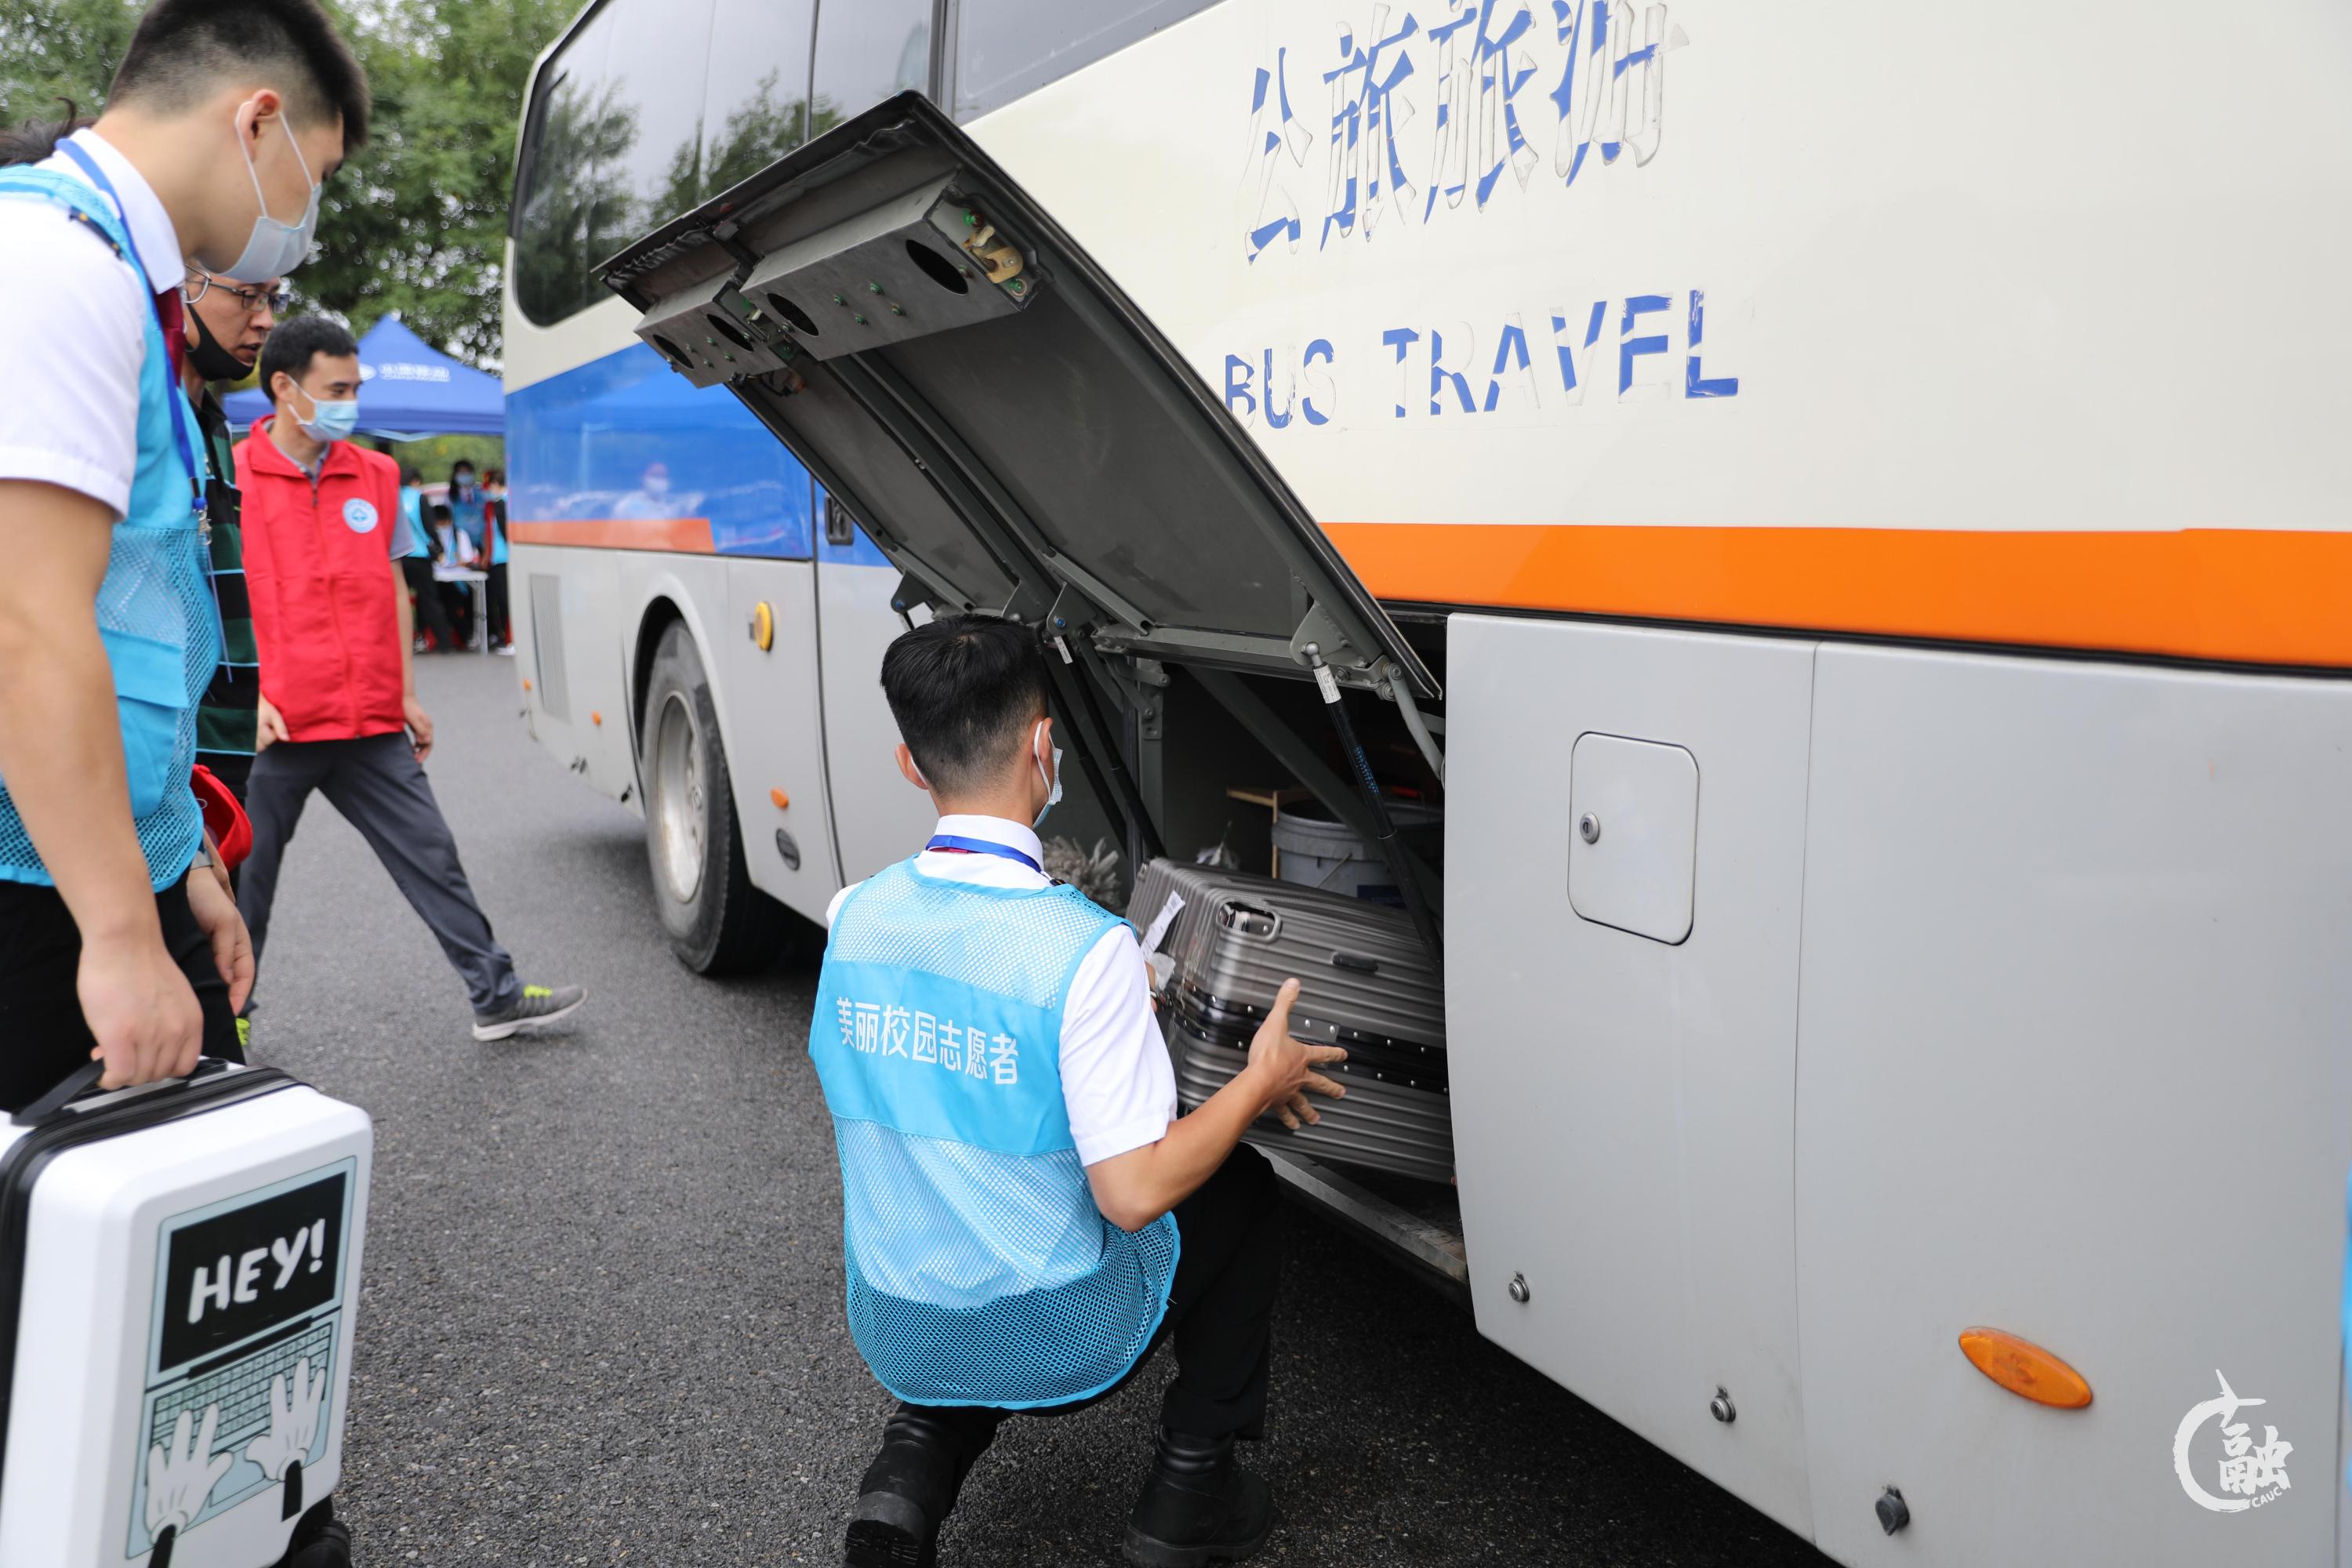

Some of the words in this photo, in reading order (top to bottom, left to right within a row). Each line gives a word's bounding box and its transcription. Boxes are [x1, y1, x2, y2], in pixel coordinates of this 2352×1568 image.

[1225, 339, 1336, 429] BUS
[1382, 289, 1738, 418] TRAVEL
[837, 996, 1018, 1084] 美丽校园志愿者
[187, 1218, 325, 1323] HEY!
